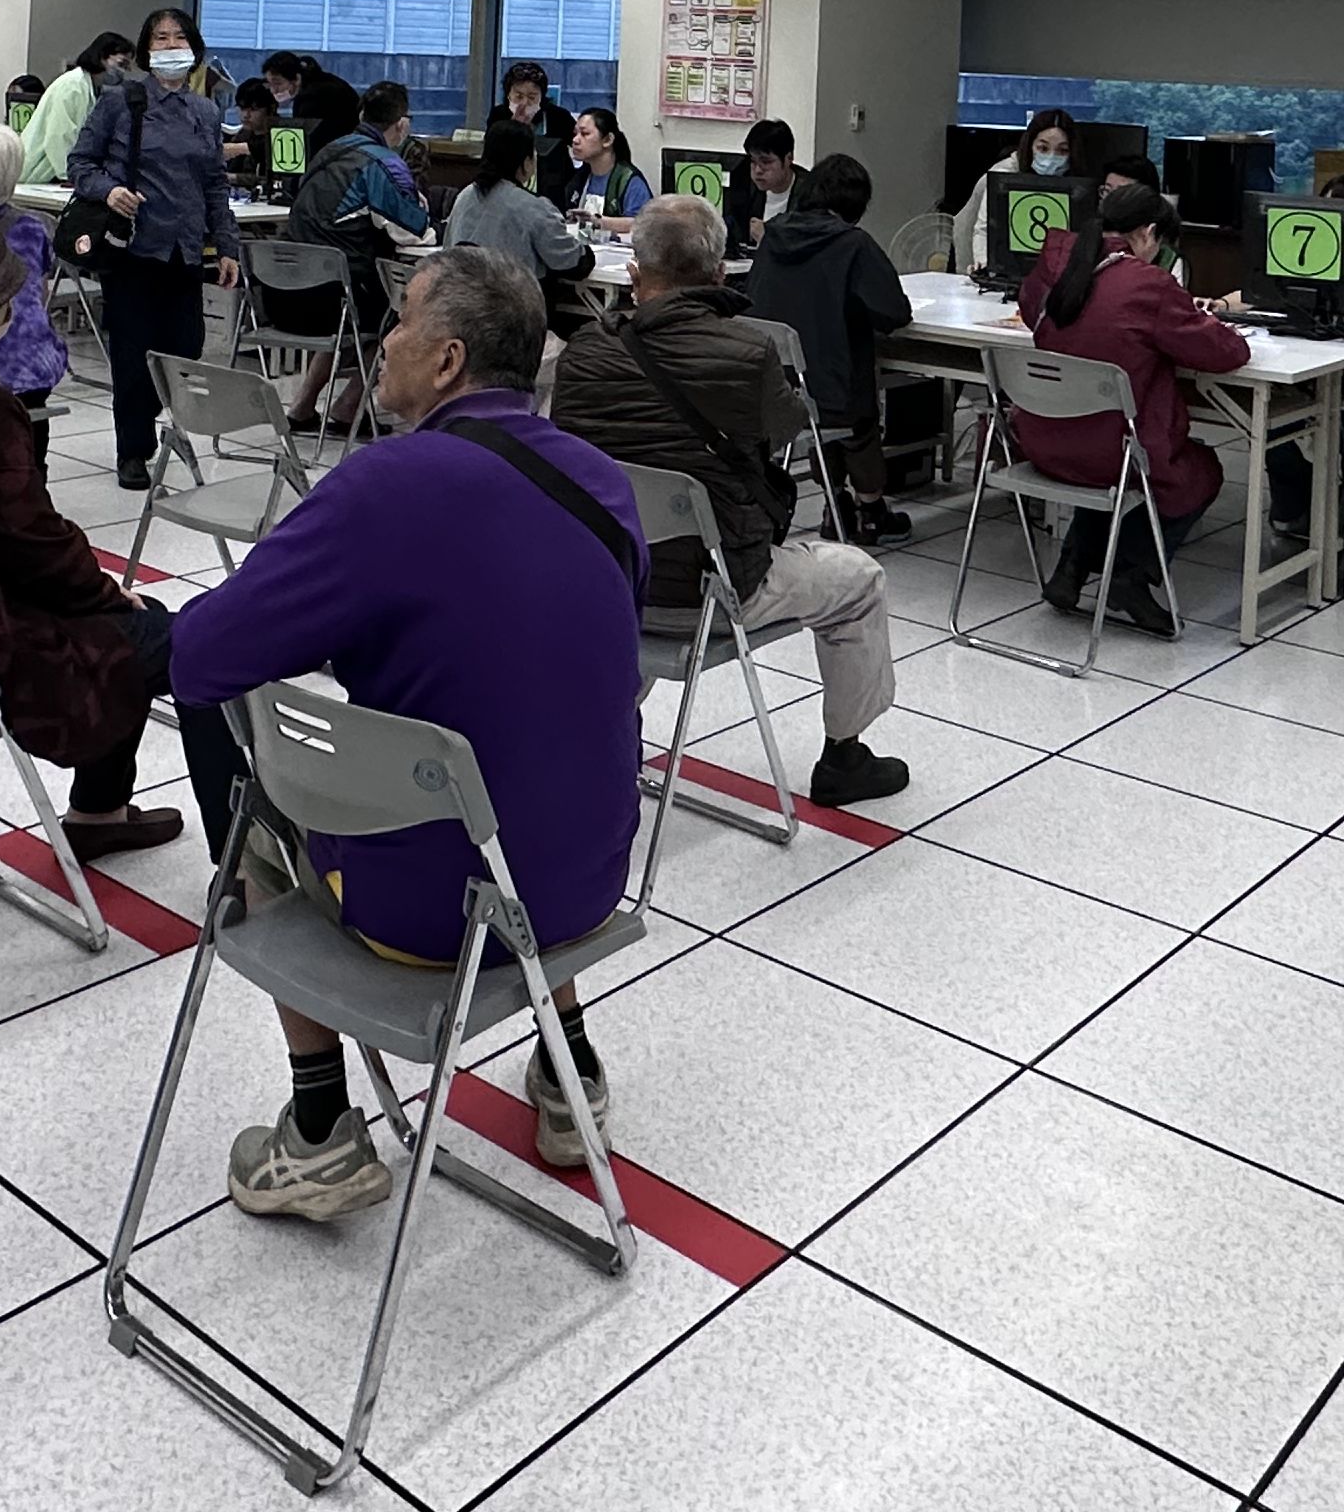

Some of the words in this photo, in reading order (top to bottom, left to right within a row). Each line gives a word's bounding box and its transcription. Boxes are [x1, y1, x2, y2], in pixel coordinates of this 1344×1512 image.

[277, 143, 299, 166] 11
[689, 174, 706, 198] 9
[1028, 205, 1050, 243] 8
[1291, 224, 1316, 266] 7
